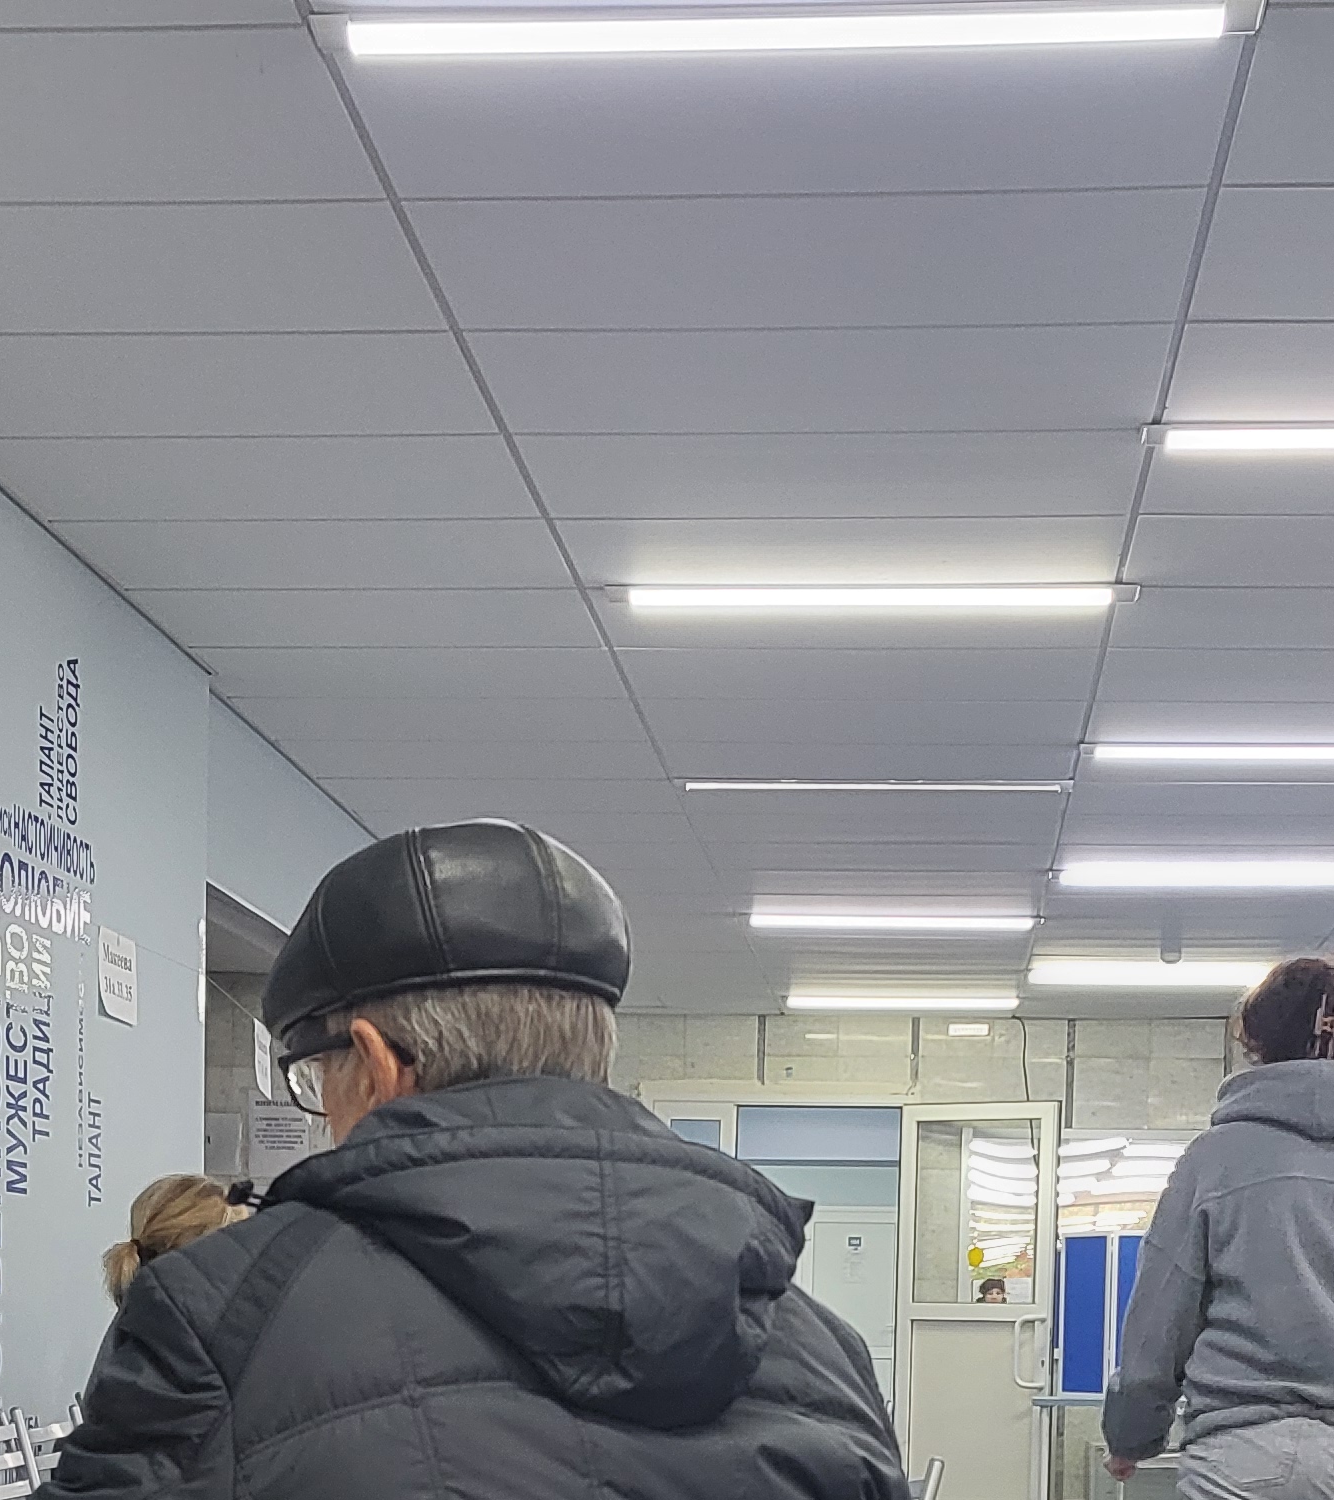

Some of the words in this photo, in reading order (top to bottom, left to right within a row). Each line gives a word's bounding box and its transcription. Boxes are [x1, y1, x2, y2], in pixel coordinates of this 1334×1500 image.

[38, 705, 55, 809] ТАЛАНТ
[56, 663, 65, 824] ЛИДЕРСТВО
[65, 658, 81, 826] СВОБОДА
[12, 803, 96, 885] НАСТОЙЧИВОСТЬ
[5, 923, 29, 1196] МУЖЕСТВО
[31, 934, 54, 1143] ТРАДИЦИИ
[87, 1091, 102, 1208] ТАЛАНТ
